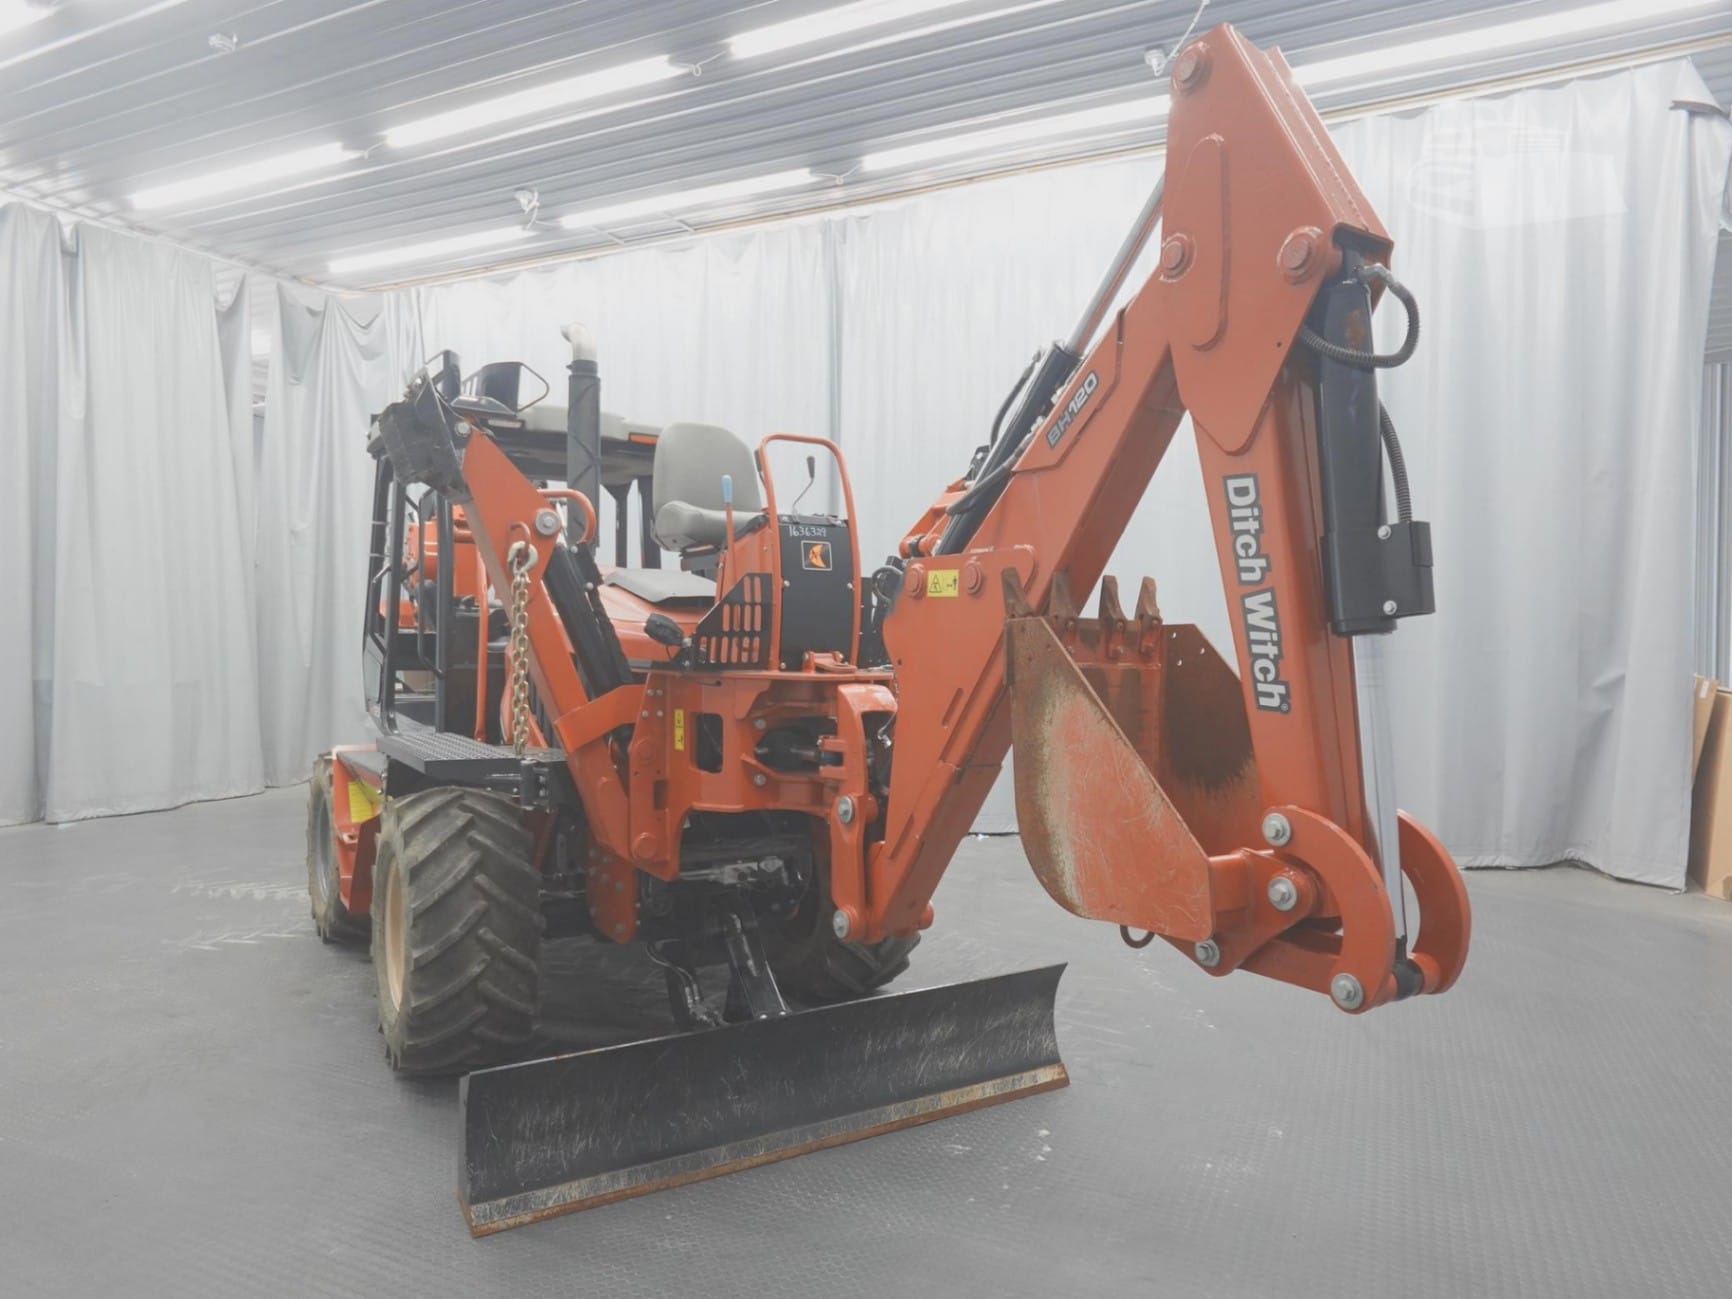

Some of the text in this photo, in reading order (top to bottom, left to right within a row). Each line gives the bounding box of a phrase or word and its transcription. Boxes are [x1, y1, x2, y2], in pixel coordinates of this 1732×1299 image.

[1047, 372, 1098, 447] BH120
[1226, 477, 1287, 708] Ditch Witch
